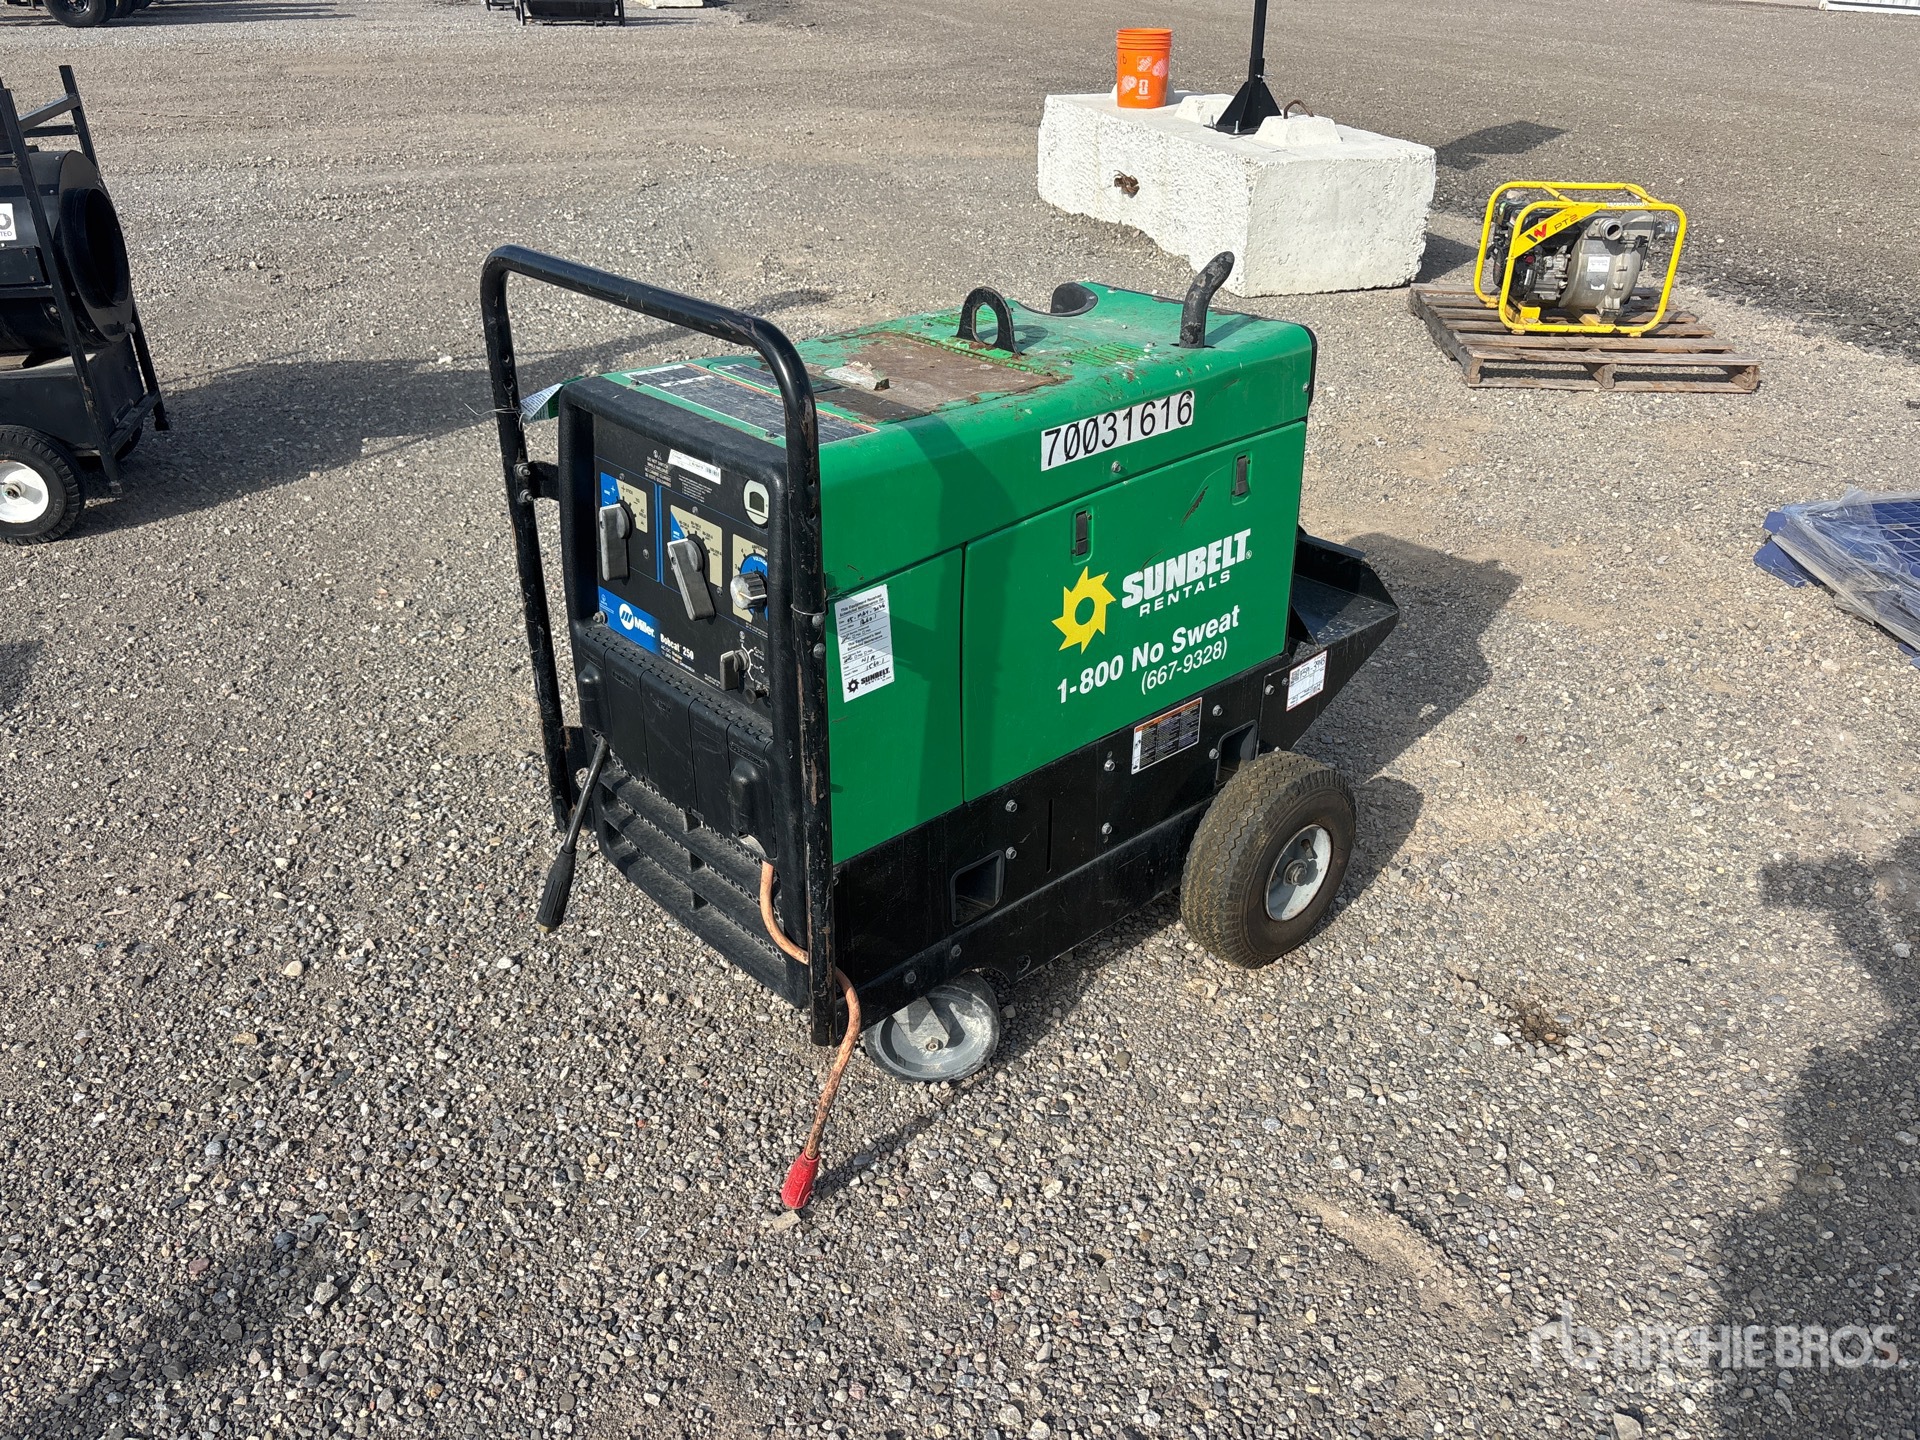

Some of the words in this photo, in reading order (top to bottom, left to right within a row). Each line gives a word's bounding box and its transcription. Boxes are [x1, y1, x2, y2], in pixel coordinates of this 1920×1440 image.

[1044, 391, 1193, 467] 70031616
[1121, 528, 1253, 610] SUNBELT
[1139, 570, 1231, 617] RENTALS
[634, 616, 655, 638] Miller
[660, 633, 681, 652] Bobcat
[682, 646, 695, 660] 250
[860, 667, 890, 684] SUNBELT
[1056, 654, 1124, 704] 1-800
[1131, 639, 1164, 673] No
[1170, 604, 1241, 655] Sweat
[1140, 636, 1229, 696] (667-9328)
